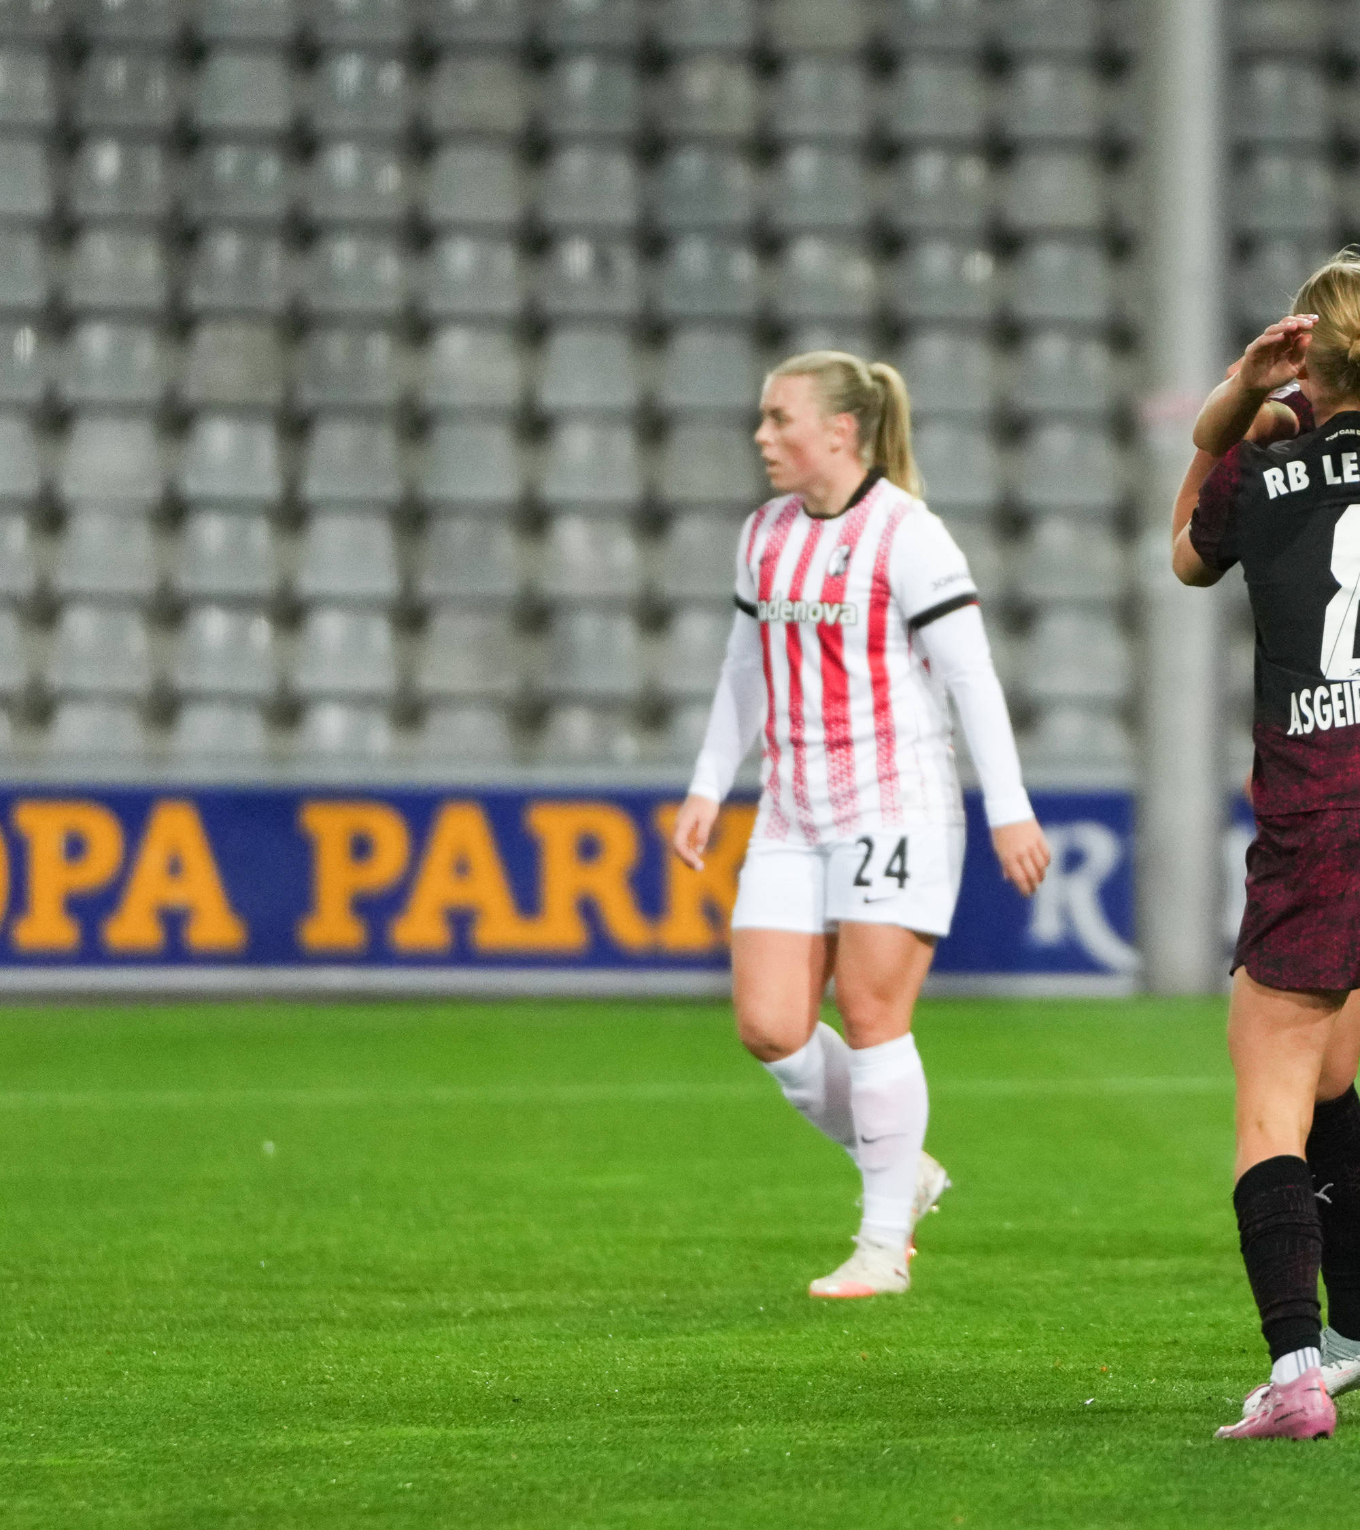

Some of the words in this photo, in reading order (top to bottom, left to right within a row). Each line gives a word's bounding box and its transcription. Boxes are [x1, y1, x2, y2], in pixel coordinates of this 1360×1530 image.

[1263, 460, 1310, 499] RB
[0, 799, 247, 952] PA
[852, 836, 910, 890] 24
